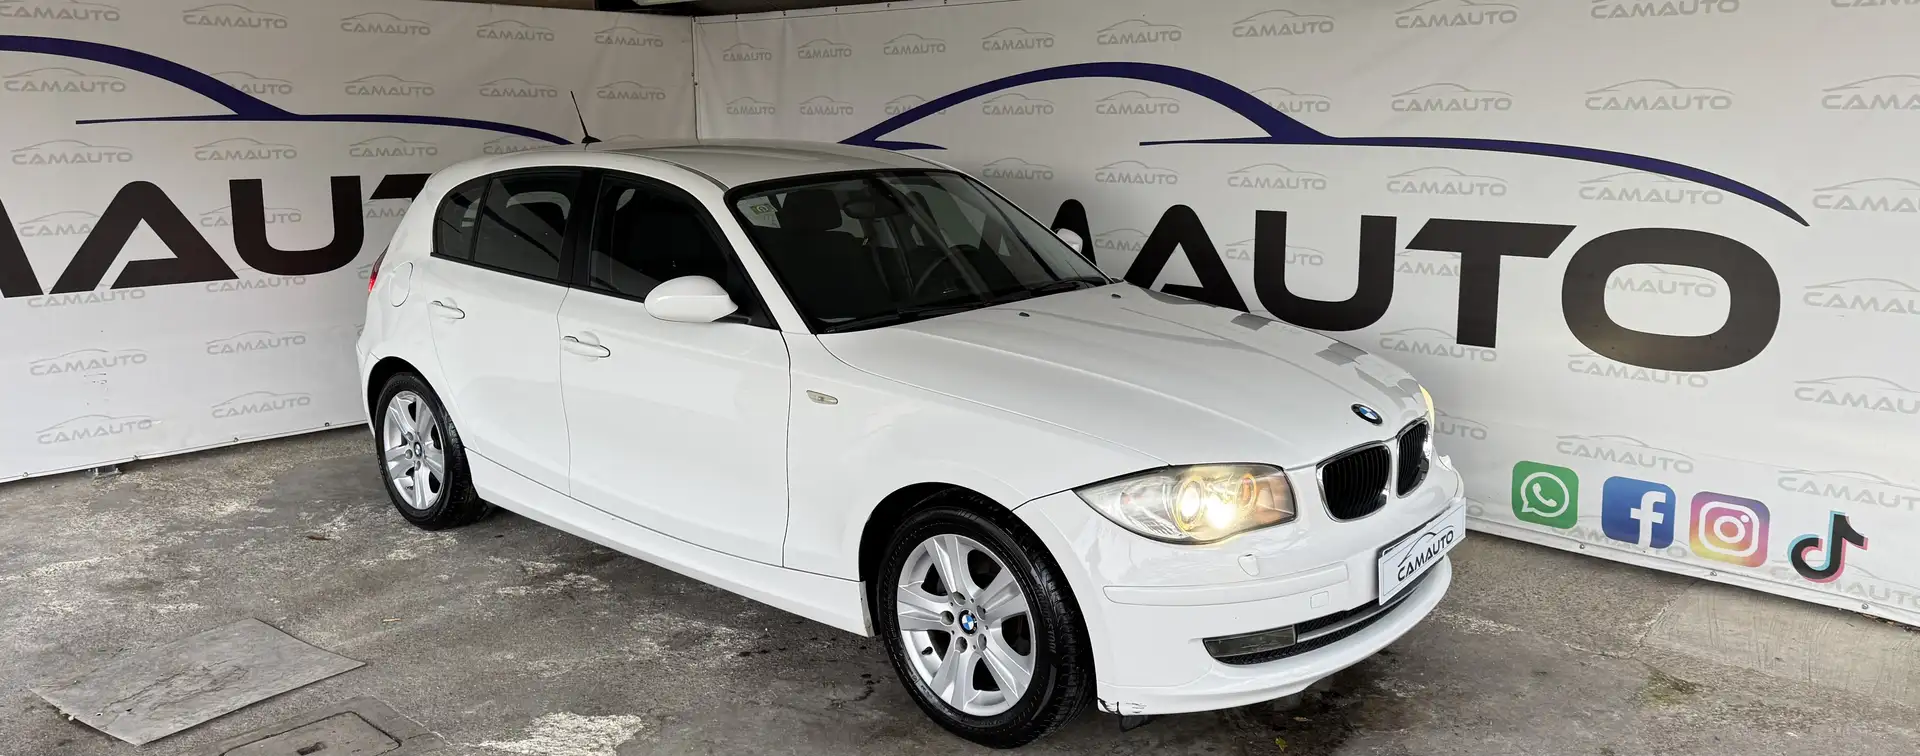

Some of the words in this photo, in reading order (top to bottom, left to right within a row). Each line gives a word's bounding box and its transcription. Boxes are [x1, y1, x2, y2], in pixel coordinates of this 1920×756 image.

[1590, 0, 1740, 19] CAMAUTO
[182, 14, 288, 30] CAMAUTO
[1395, 10, 1517, 29] CAMAUTO
[341, 22, 431, 36] CAMAUTO
[476, 29, 555, 42] CAMAUTO
[1232, 21, 1334, 38] CAMAUTO
[595, 35, 664, 48] CAMAUTO
[982, 37, 1055, 51] CAMAUTO
[1097, 30, 1182, 45] CAMAUTO
[798, 48, 852, 59] CAMAUTO
[883, 43, 946, 56] CAMAUTO
[723, 52, 772, 62] CAMAUTO
[4, 80, 126, 93] CAMAUTO
[345, 85, 434, 97] CAMAUTO
[479, 87, 558, 99] CAMAUTO
[596, 90, 666, 101] CAMAUTO
[726, 105, 775, 115] CAMAUTO
[800, 105, 853, 115] CAMAUTO
[982, 104, 1054, 115] CAMAUTO
[1096, 103, 1180, 115] CAMAUTO
[1392, 98, 1512, 112] CAMAUTO
[1585, 95, 1732, 111] CAMAUTO
[12, 152, 133, 165] CAMAUTO
[194, 149, 297, 161] CAMAUTO
[349, 146, 438, 158] CAMAUTO
[982, 168, 1054, 180] CAMAUTO
[1095, 172, 1178, 184] CAMAUTO
[1227, 176, 1327, 190] CAMAUTO
[1387, 181, 1507, 197] CAMAUTO
[1579, 186, 1723, 205] CAMAUTO
[206, 276, 306, 293] CAMAUTO
[27, 289, 146, 308] CAMAUTO
[207, 335, 306, 355] CAMAUTO
[1380, 338, 1497, 362] CAMAUTO
[30, 353, 148, 377] CAMAUTO
[1568, 360, 1709, 388] CAMAUTO
[212, 396, 311, 419] CAMAUTO
[37, 418, 153, 446] CAMAUTO
[1556, 442, 1694, 474] CAMAUTO
[1397, 530, 1454, 581] CAMAUTO
